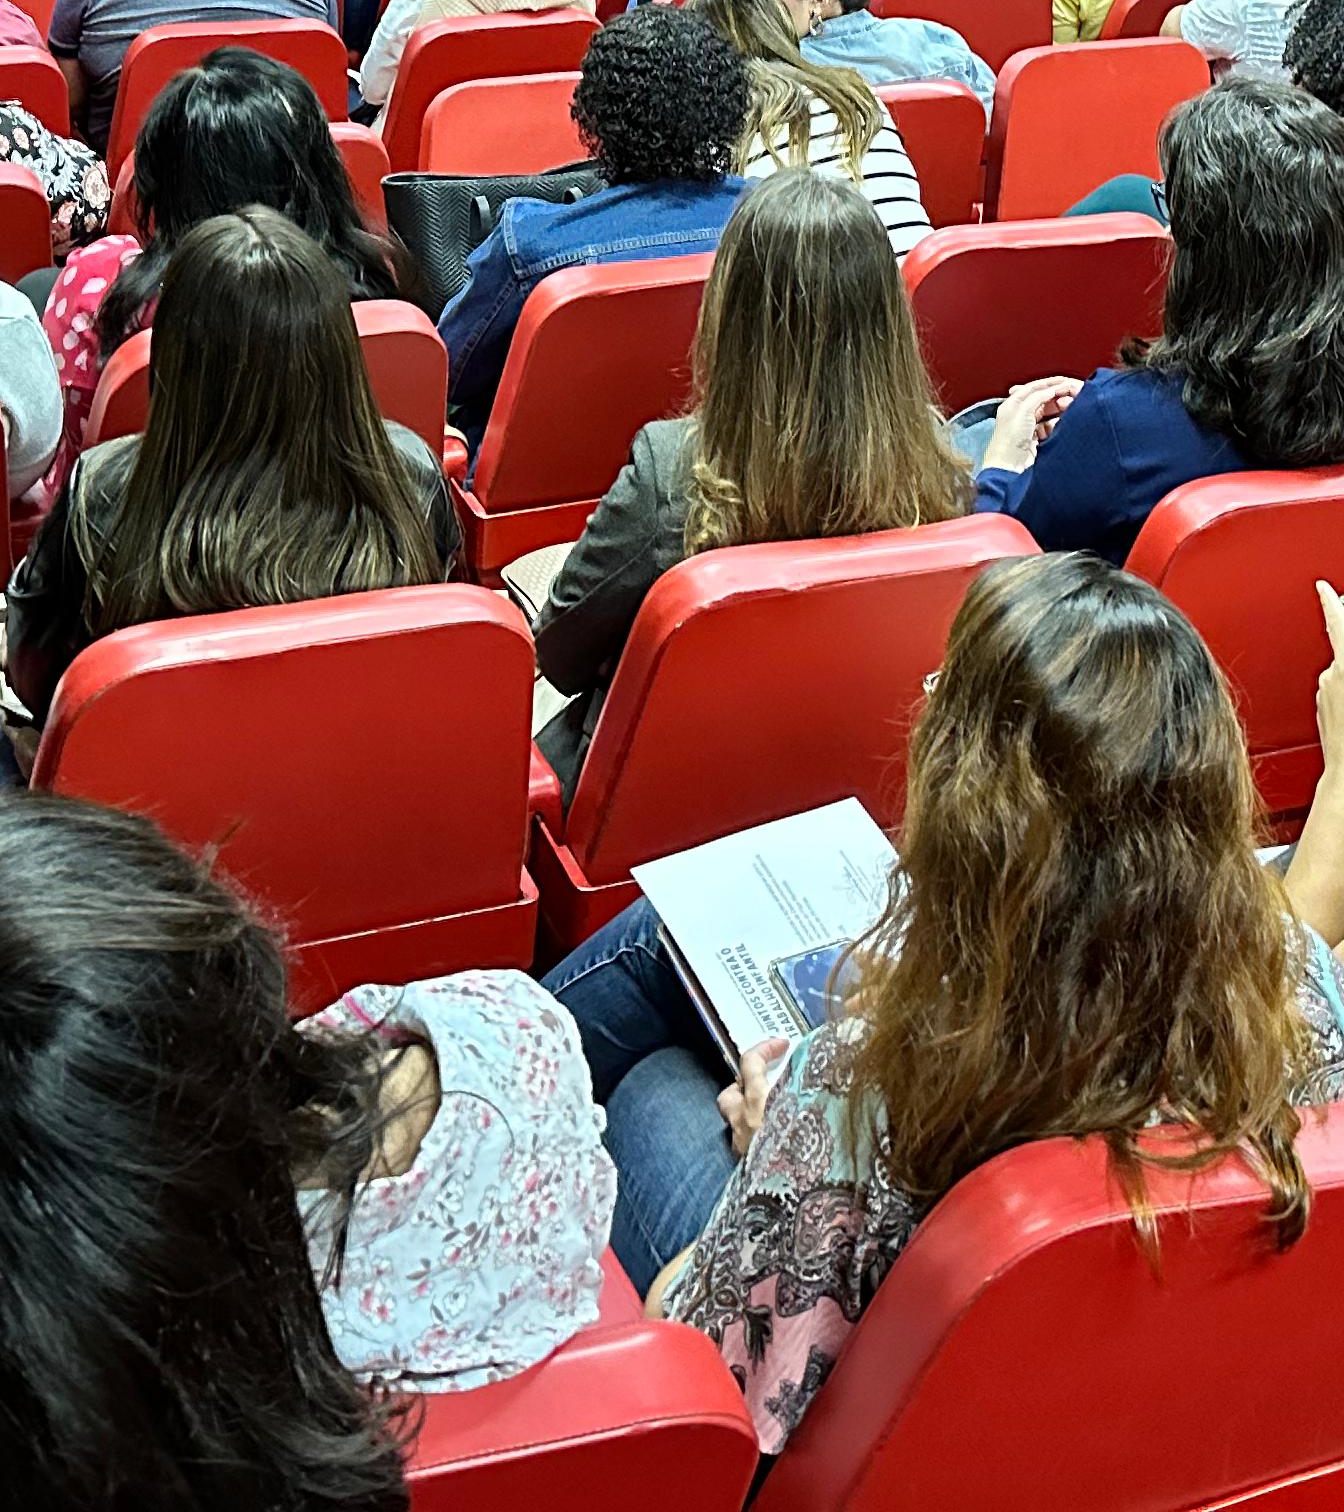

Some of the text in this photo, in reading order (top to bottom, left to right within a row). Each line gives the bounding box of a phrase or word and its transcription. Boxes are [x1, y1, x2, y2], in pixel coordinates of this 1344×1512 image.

[721, 947, 732, 955] O
[735, 942, 768, 986] INFANTIL
[726, 955, 756, 995] CONTRA
[750, 996, 780, 1033] JUNTOS
[761, 987, 799, 1039] TRABALHO
